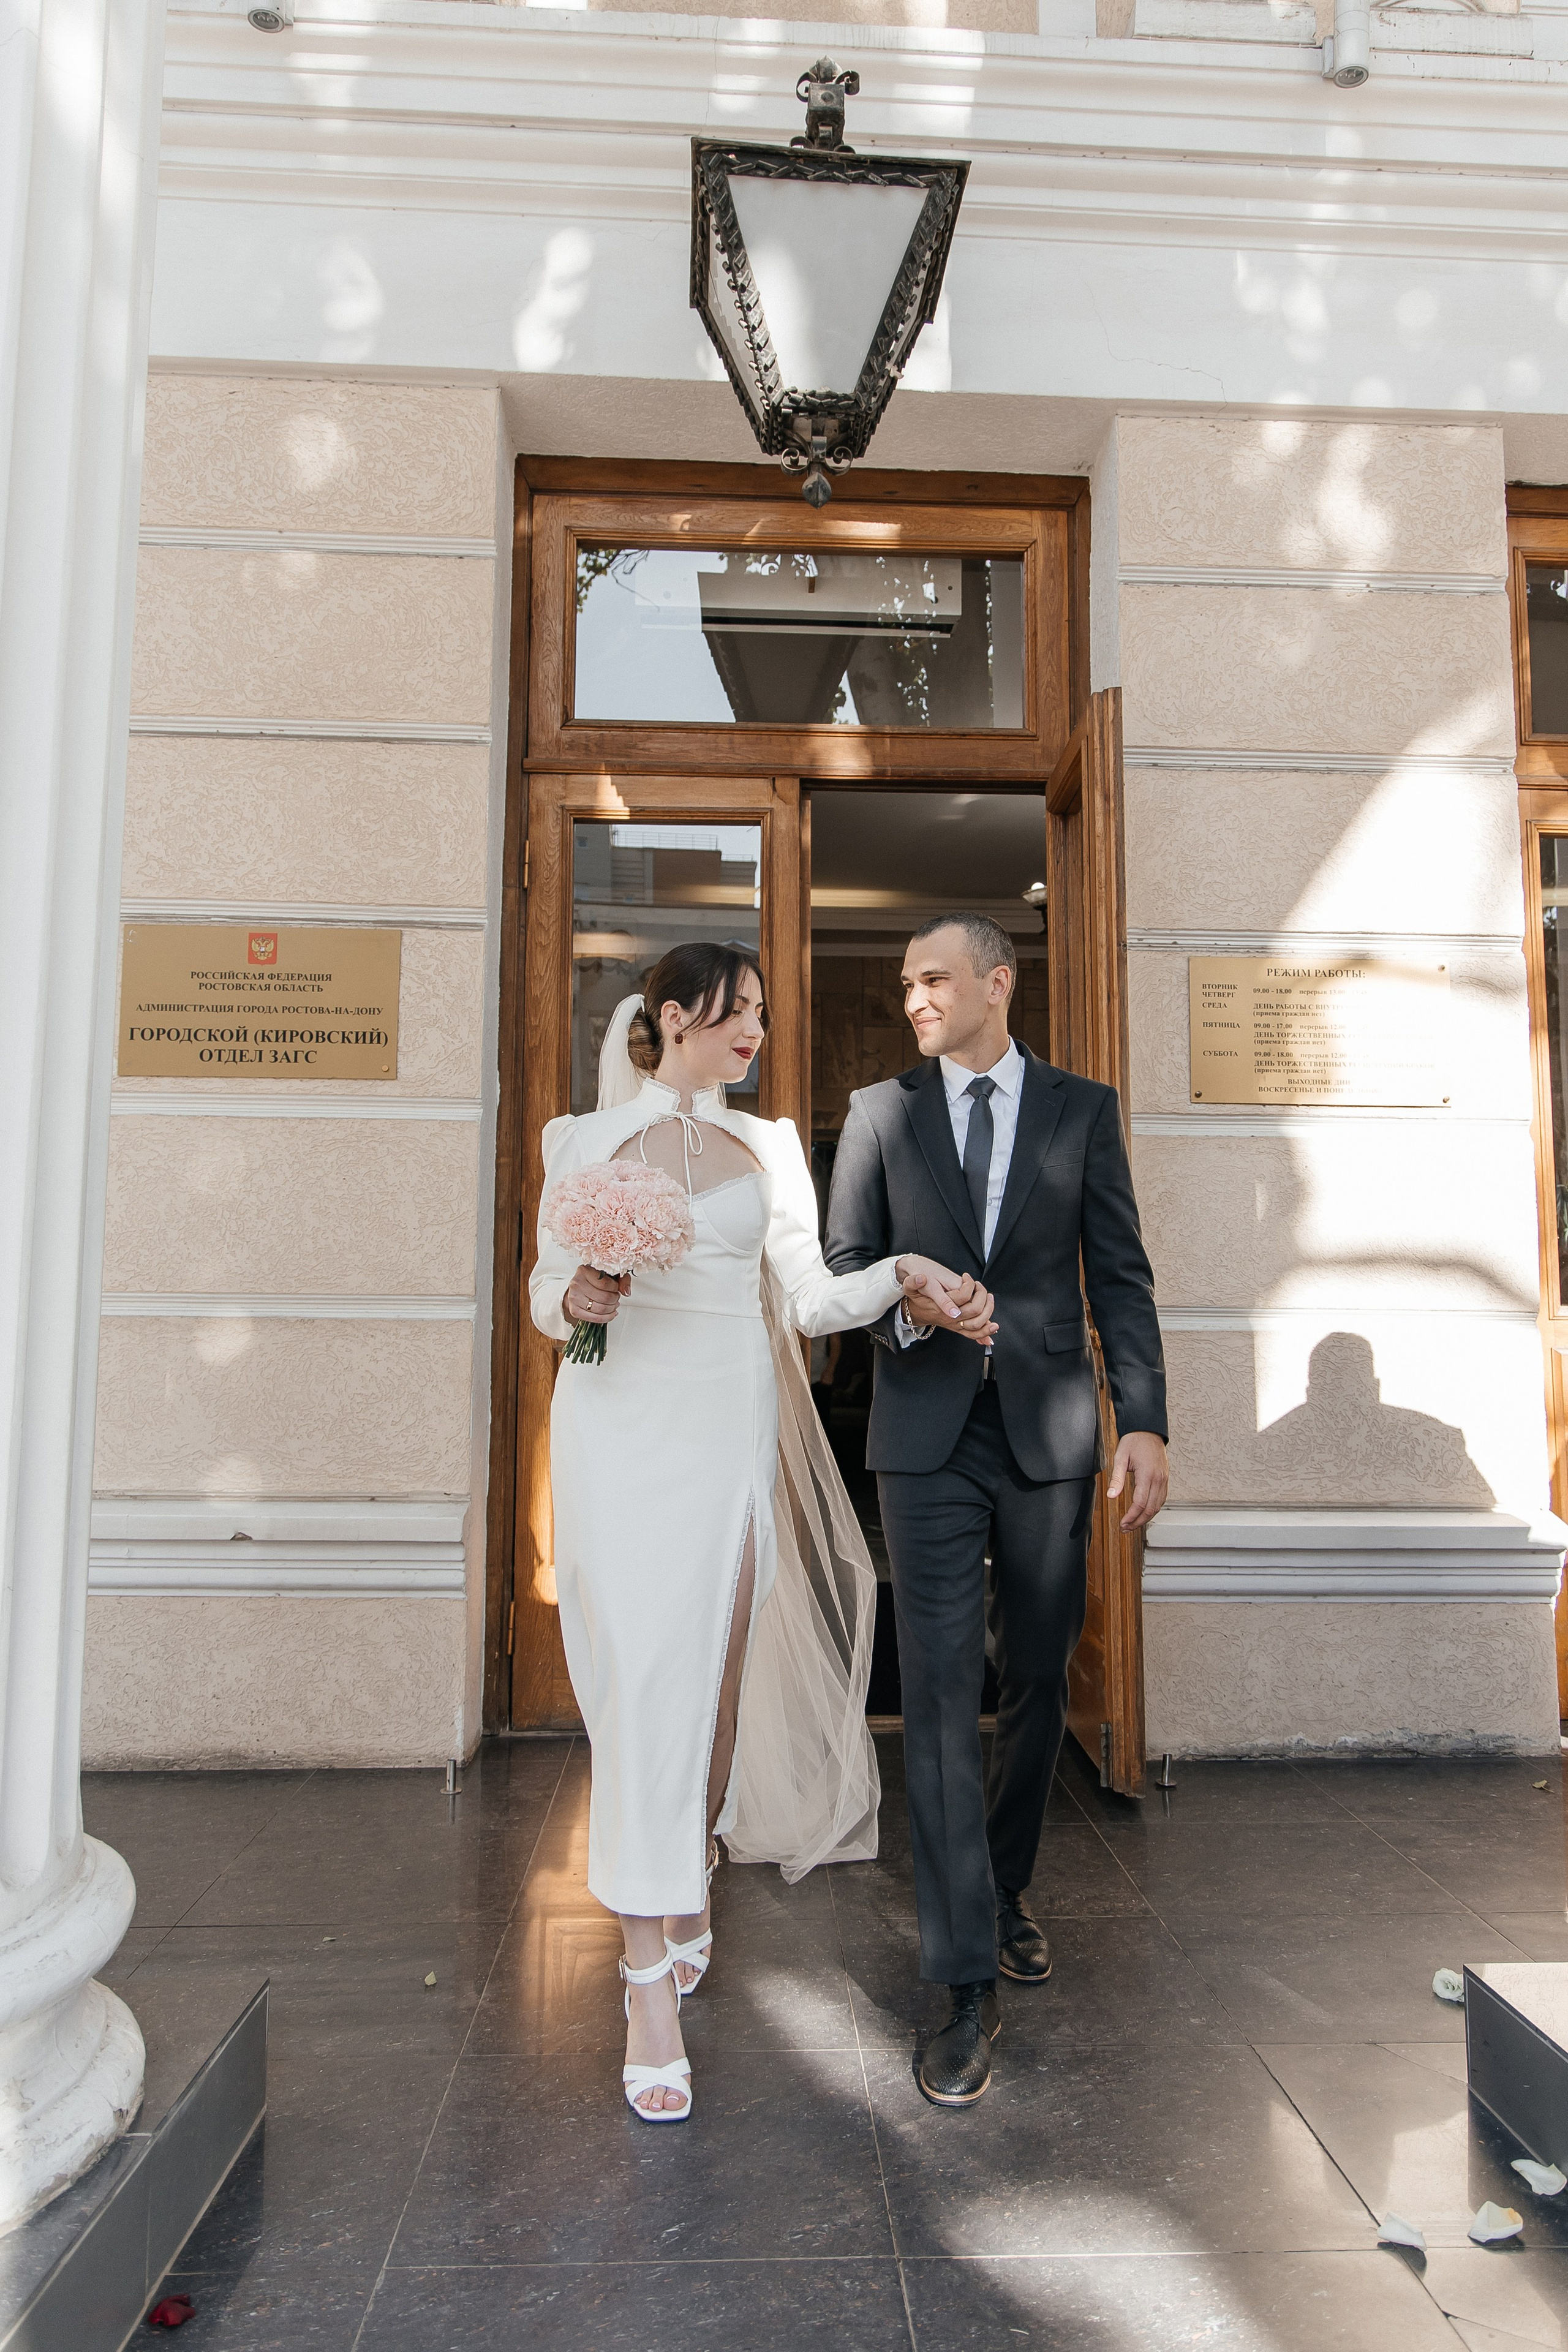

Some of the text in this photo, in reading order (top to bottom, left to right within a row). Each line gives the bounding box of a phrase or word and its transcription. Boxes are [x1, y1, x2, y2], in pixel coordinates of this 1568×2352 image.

[190, 970, 332, 982] РОССИЙСКАЯ ФЕДЕРАЦИЯ
[1267, 968, 1366, 979] РЕЖИМ РАБОТЫ:
[198, 982, 323, 993] РОСТОВСКАЯ ОБЛАСТЬ
[135, 1003, 384, 1016] АДМИНИСТРАЦИЯ ГОРОДА РОСТОВА-НА-ДОНУ
[129, 1025, 389, 1047] ГОРОДСКОЙ (КИРОВСКИЙ)
[198, 1048, 318, 1065] ОТДЕЛ ЗАГС
